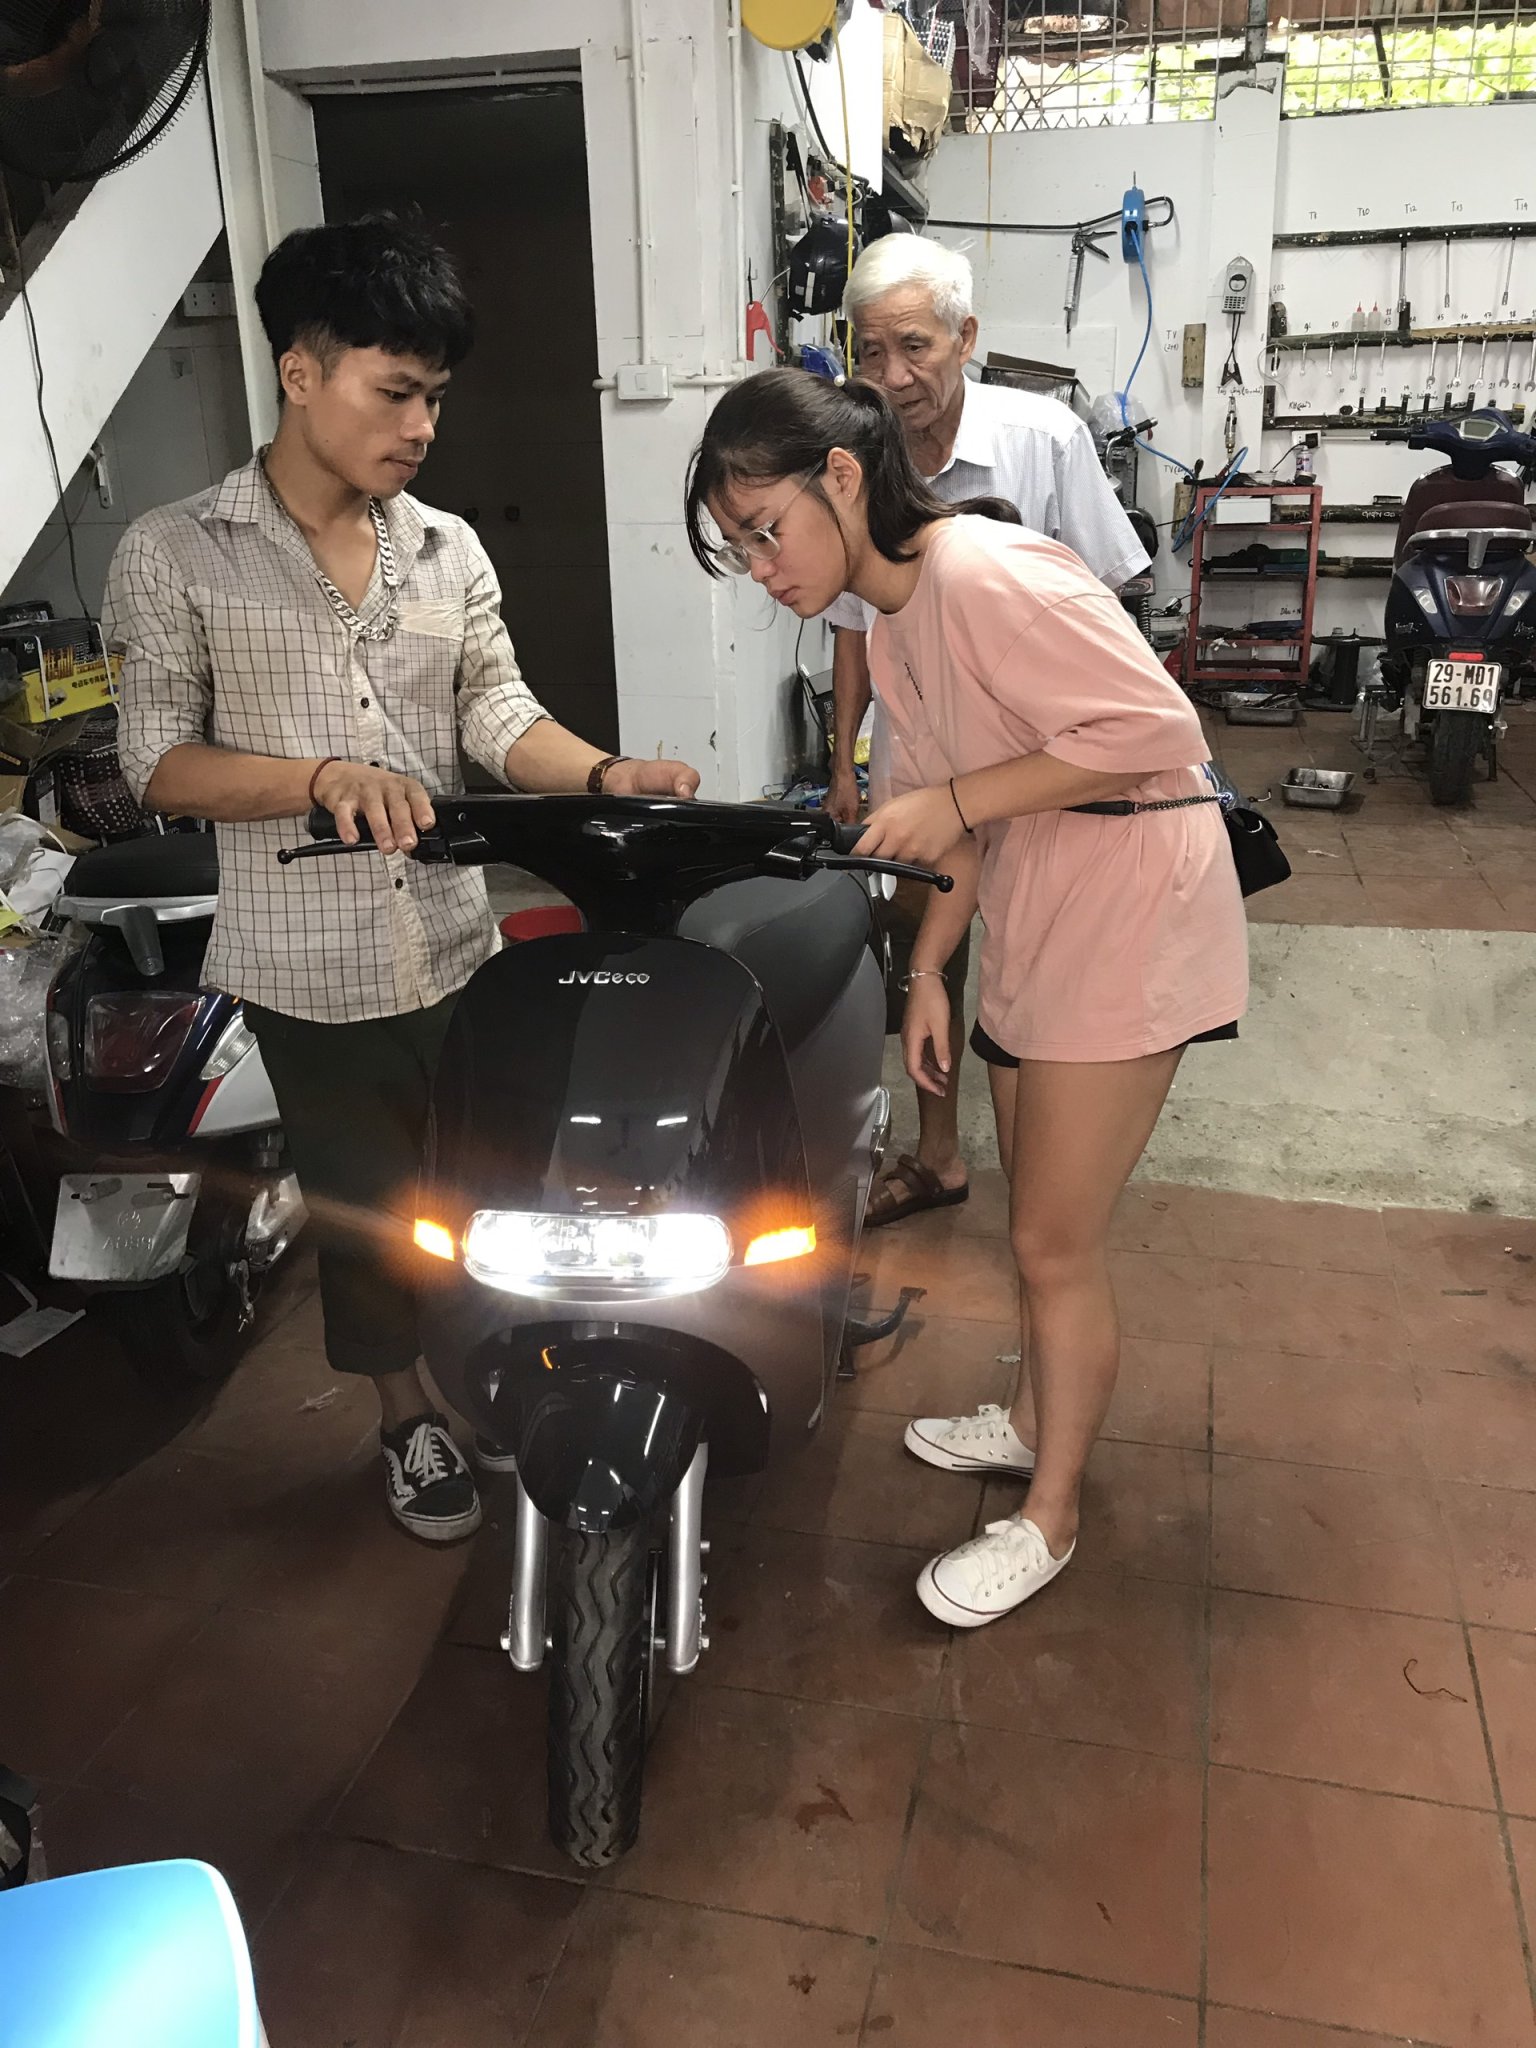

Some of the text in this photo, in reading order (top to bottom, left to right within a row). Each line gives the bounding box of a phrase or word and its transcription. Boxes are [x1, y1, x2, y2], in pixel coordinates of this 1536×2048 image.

[1357, 207, 1370, 217] T10
[1404, 203, 1418, 214] T12
[1429, 686, 1493, 709] 561.69
